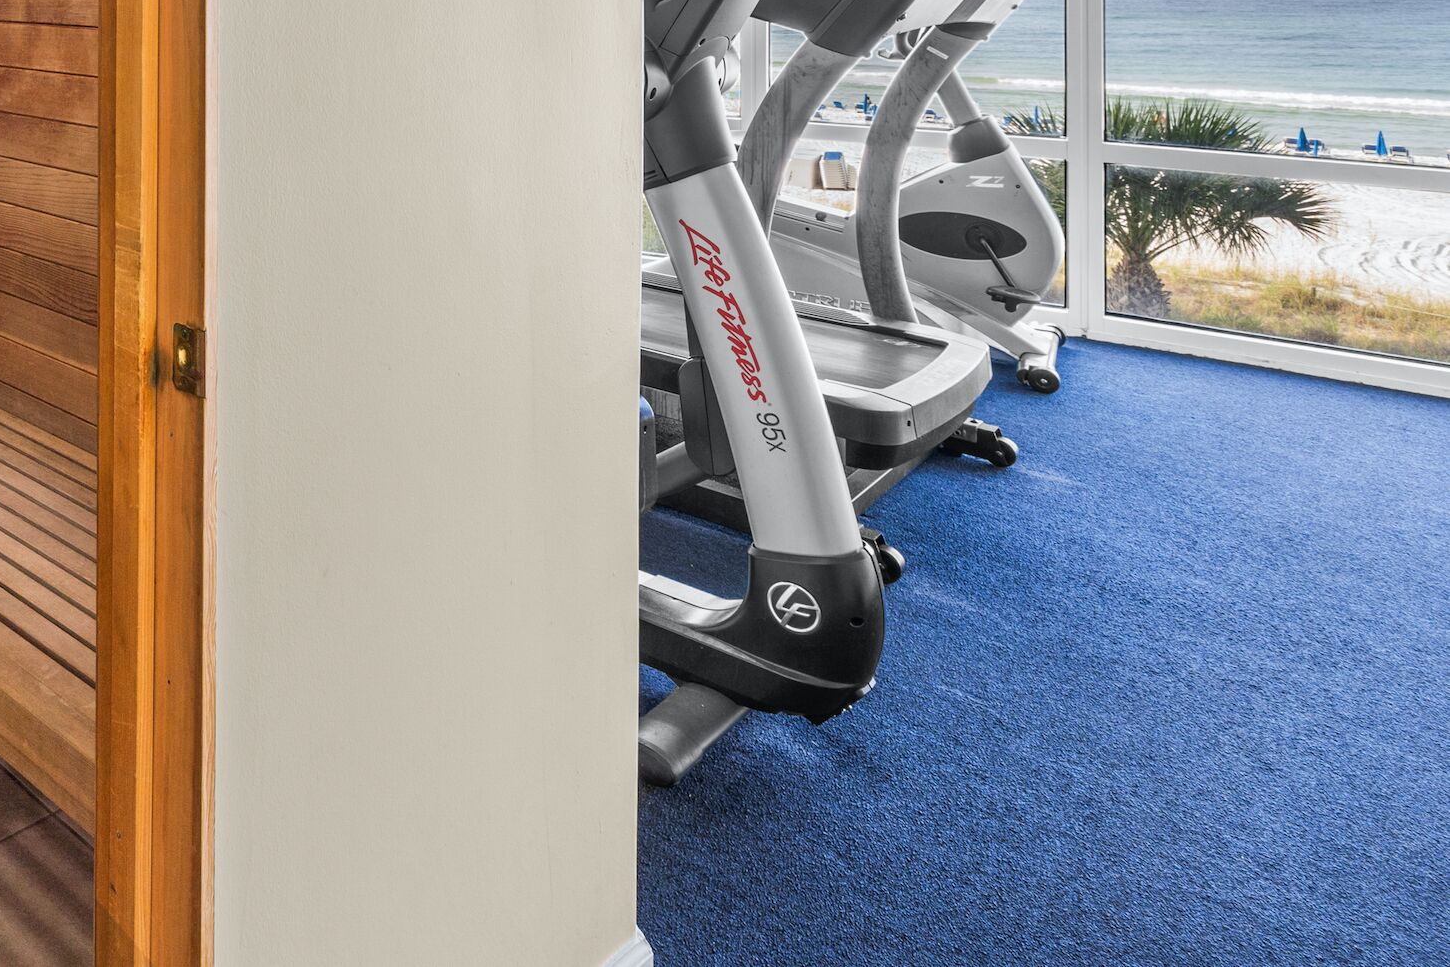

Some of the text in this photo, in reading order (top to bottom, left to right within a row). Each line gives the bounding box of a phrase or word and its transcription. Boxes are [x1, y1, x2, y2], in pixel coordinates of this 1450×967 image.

[678, 218, 767, 404] Life Fitness
[756, 412, 787, 453] 95x
